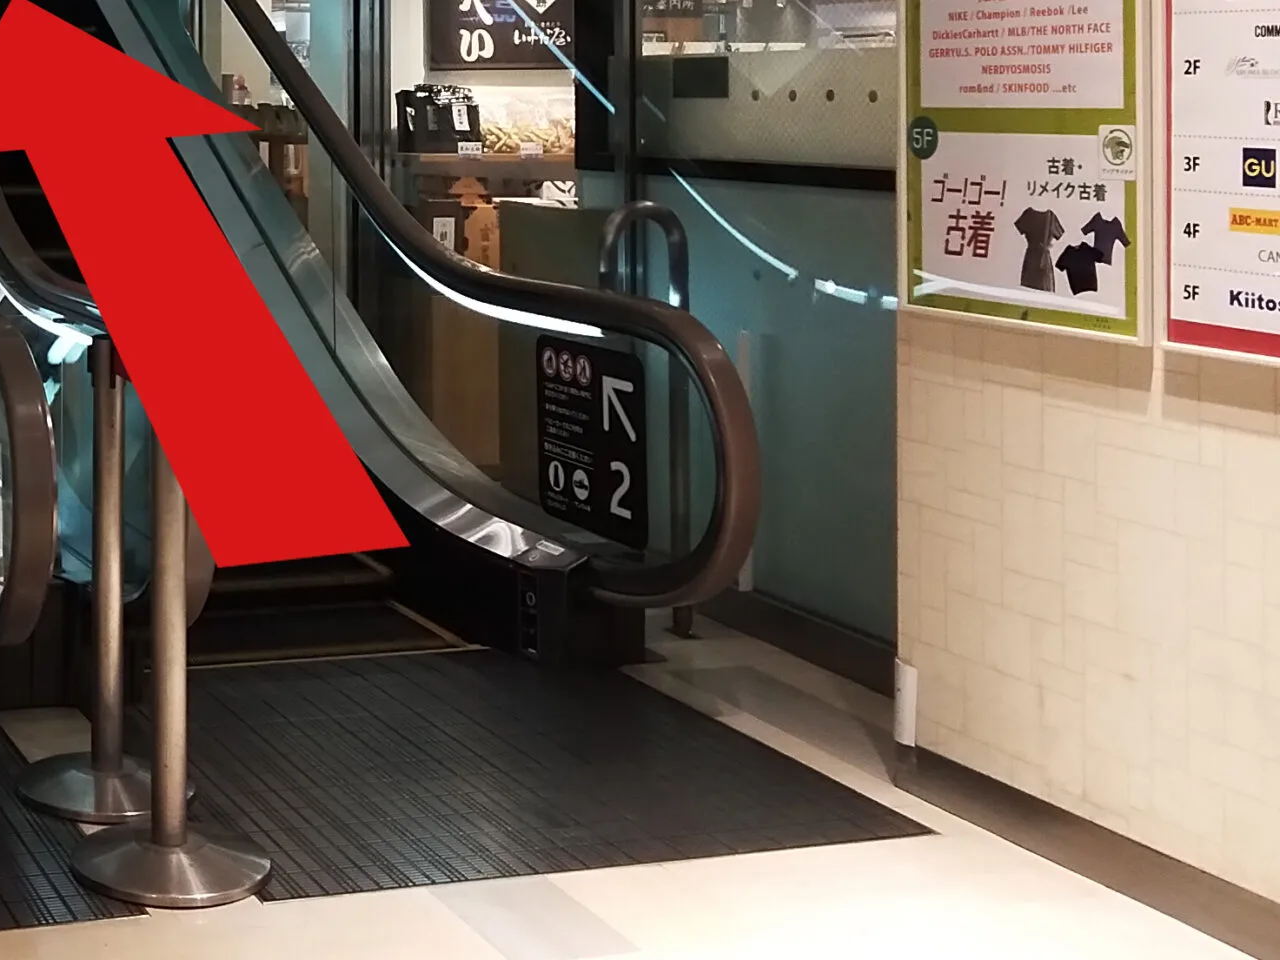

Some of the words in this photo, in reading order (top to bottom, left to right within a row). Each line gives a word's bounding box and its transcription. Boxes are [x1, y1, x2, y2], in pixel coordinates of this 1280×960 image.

[948, 11, 969, 22] NIKE
[976, 9, 1020, 22] Champion
[1030, 5, 1064, 18] Reebok
[1051, 23, 1084, 36] NORTH
[1087, 22, 1111, 34] FACE
[974, 46, 998, 57] POLO
[1069, 42, 1113, 54] HILFIGER
[1184, 59, 1201, 75] 2F
[912, 128, 933, 148] 5F
[1183, 156, 1200, 172] 3F
[1244, 158, 1276, 178] GU
[1026, 180, 1108, 202] リメイク古着
[1231, 214, 1280, 228] ABC-MART
[944, 208, 995, 259] 古着
[1183, 223, 1200, 238] 4F
[1183, 285, 1200, 300] 5F
[1229, 289, 1280, 312] Kiito
[610, 461, 632, 520] 2
